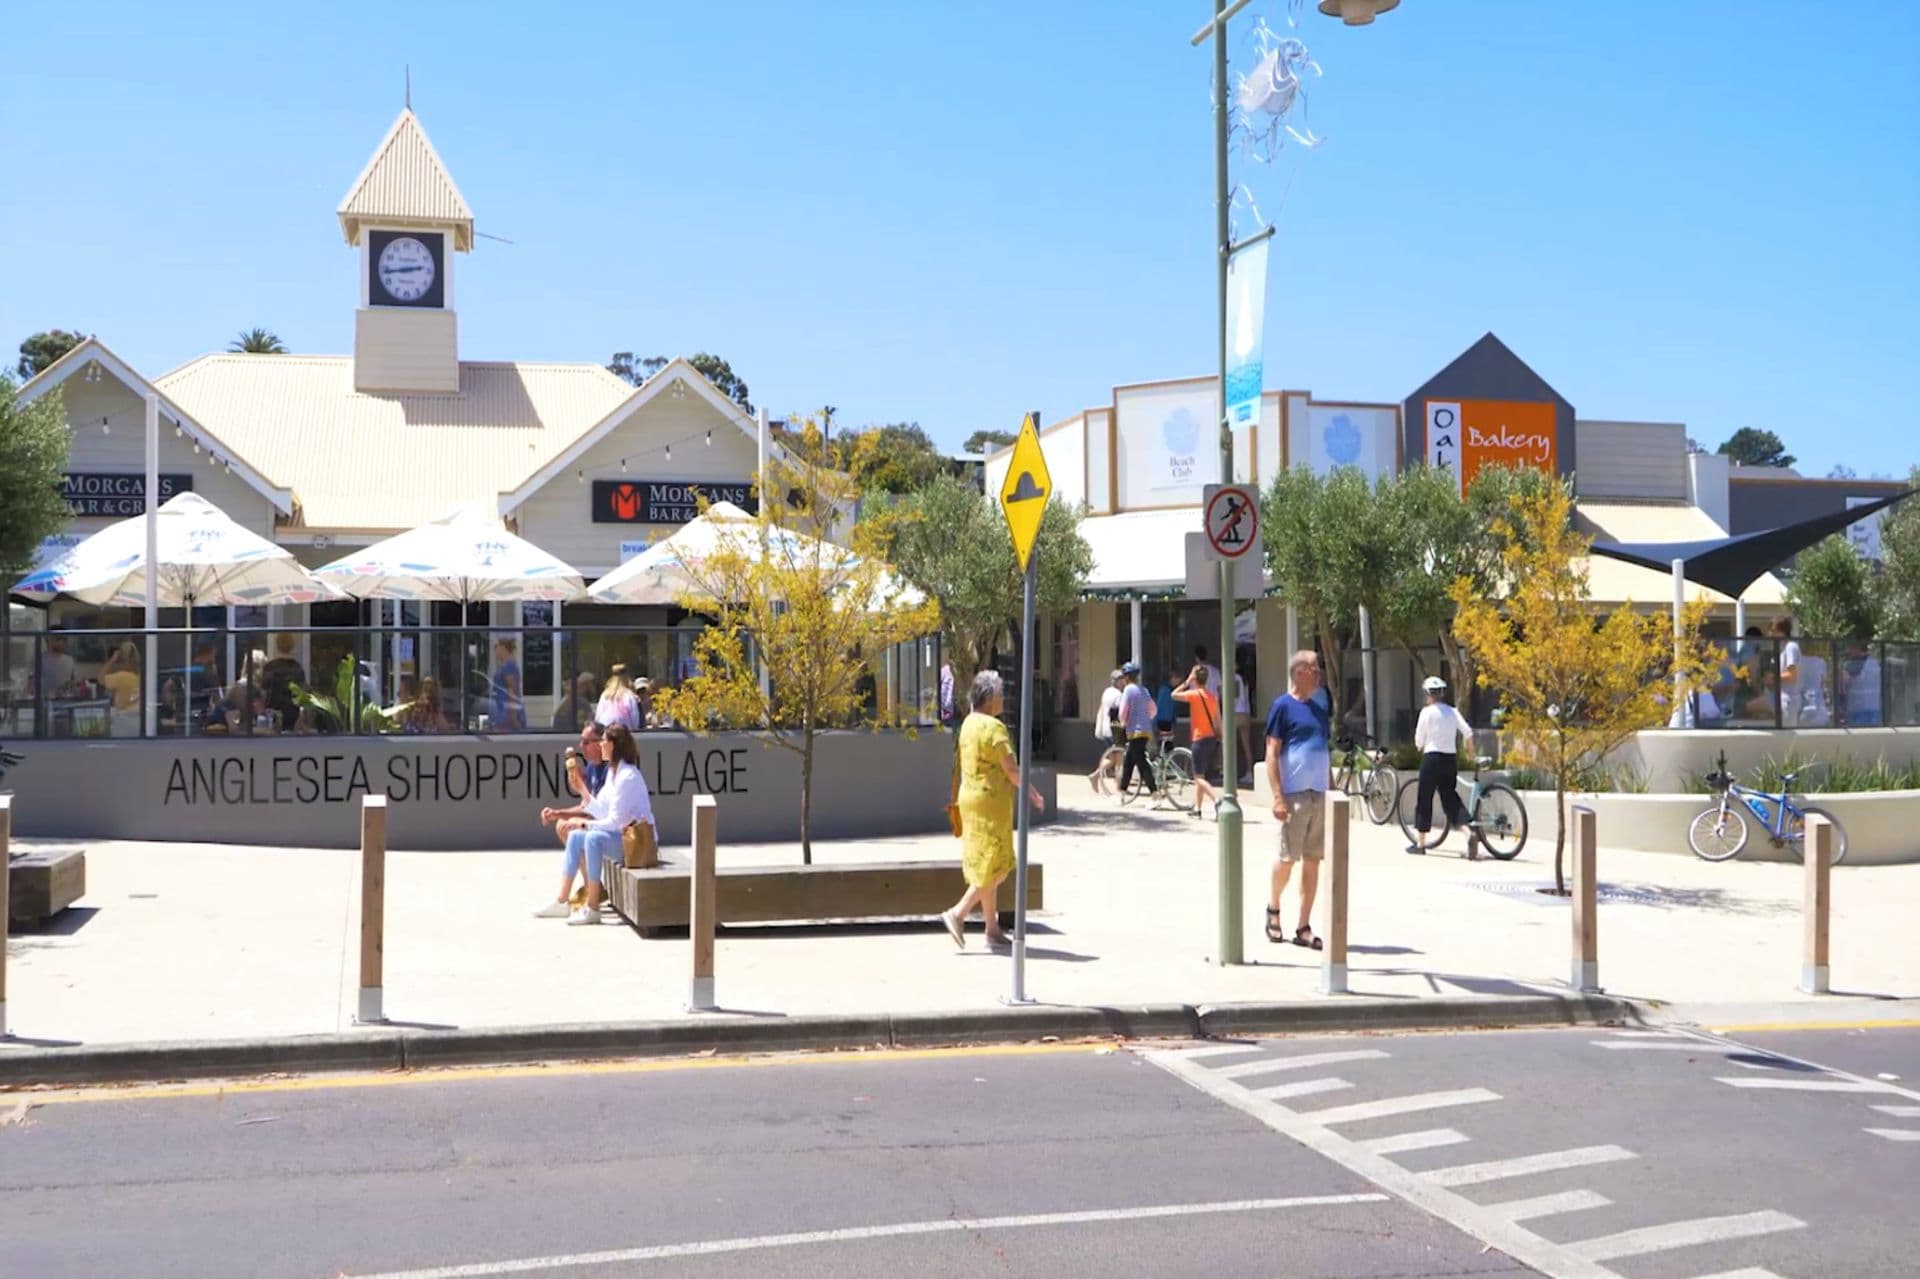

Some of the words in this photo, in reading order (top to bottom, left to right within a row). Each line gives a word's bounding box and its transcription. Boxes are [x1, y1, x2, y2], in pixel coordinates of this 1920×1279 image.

[1467, 424, 1550, 463] Bakery
[64, 475, 173, 494] MORGAS
[102, 499, 116, 514] &
[650, 507, 681, 521] BAR
[683, 509, 694, 521] &
[163, 755, 371, 805] ANGLESEA
